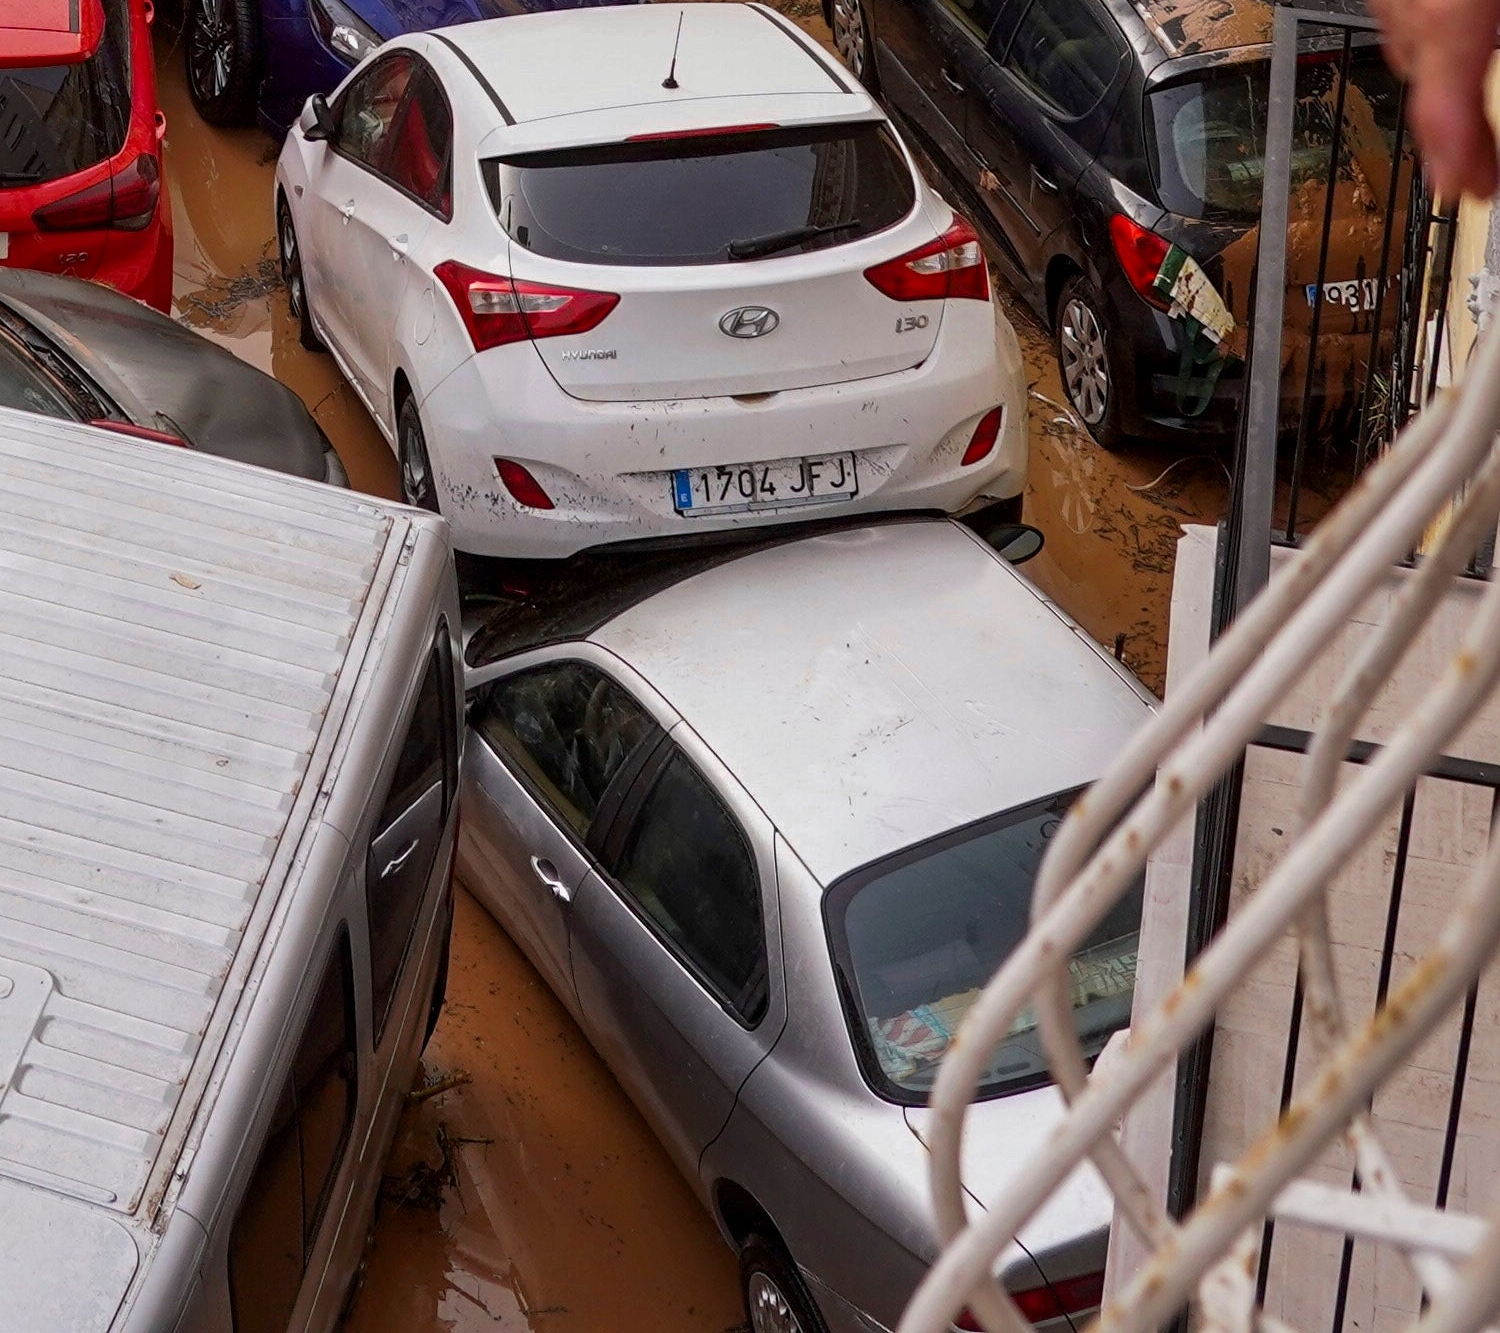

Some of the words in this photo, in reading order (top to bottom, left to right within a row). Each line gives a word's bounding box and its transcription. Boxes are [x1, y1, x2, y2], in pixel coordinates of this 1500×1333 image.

[560, 348, 618, 362] HYUNDAI
[700, 469, 777, 503] 1704
[789, 457, 846, 494] JFJ
